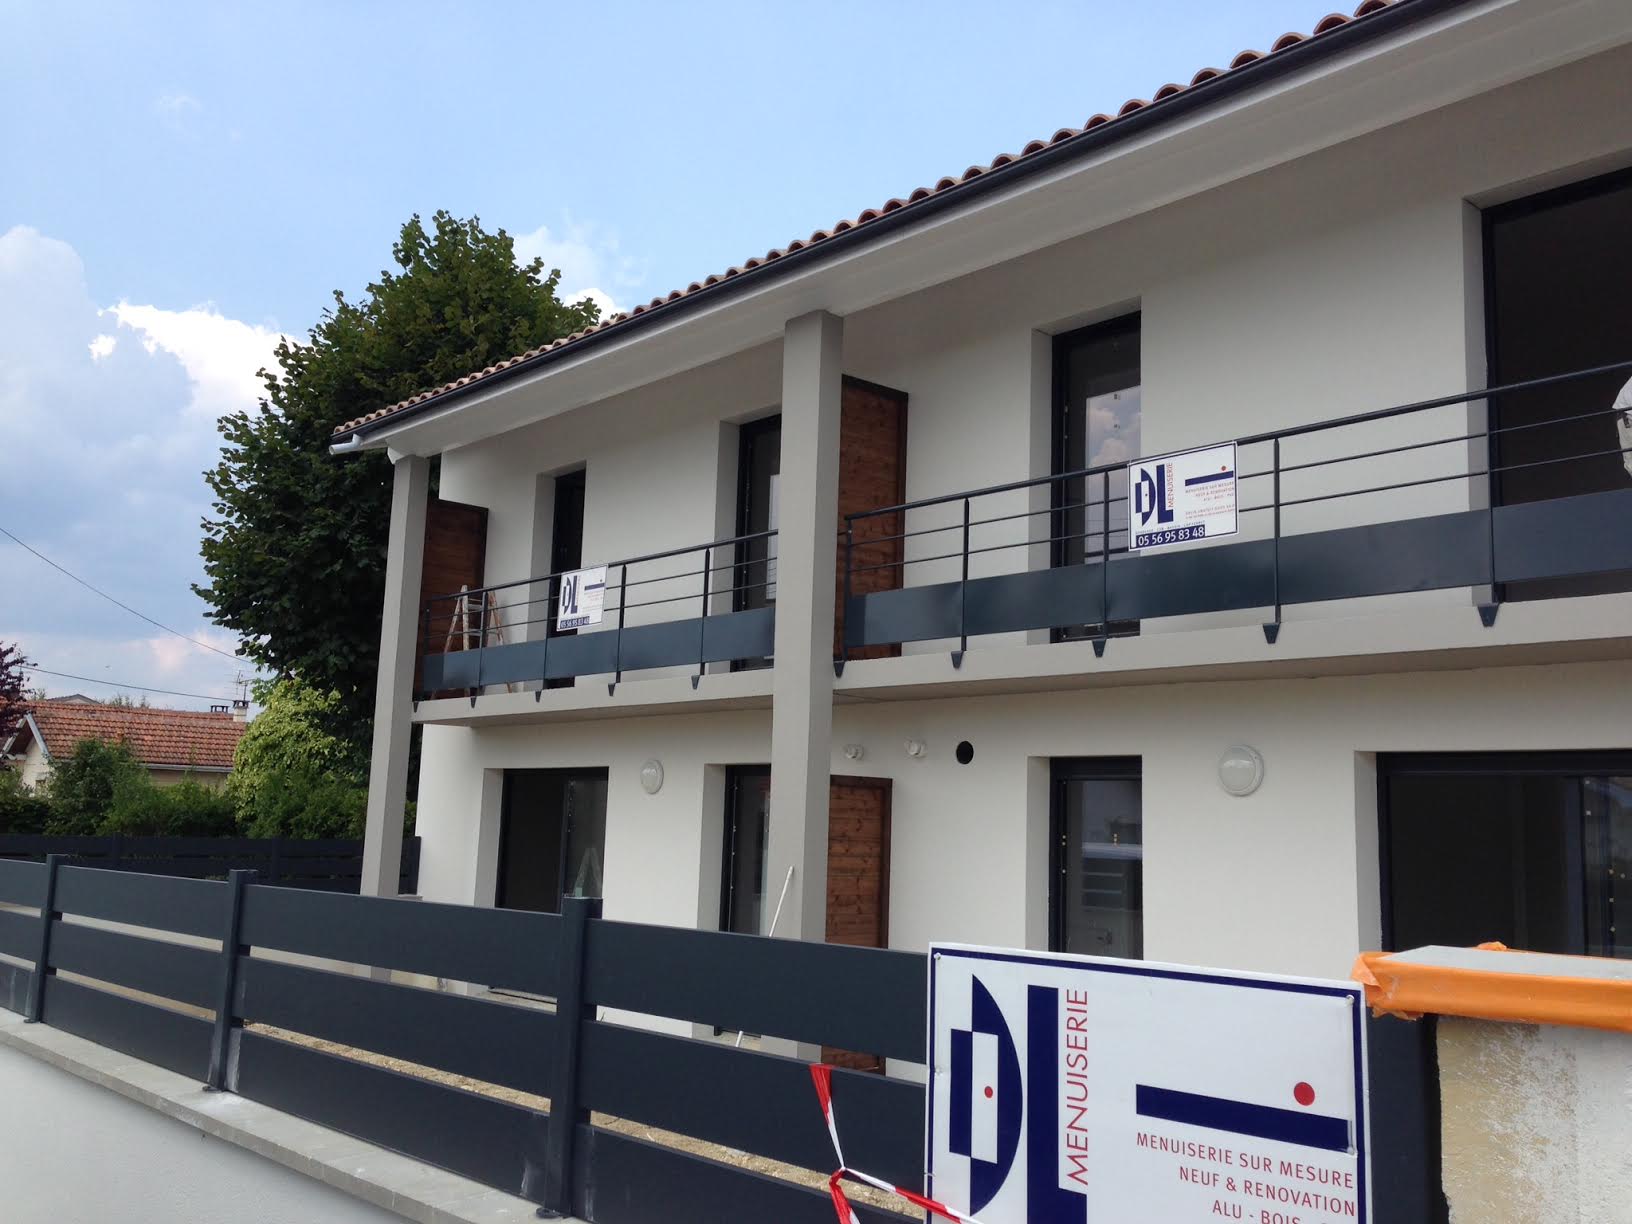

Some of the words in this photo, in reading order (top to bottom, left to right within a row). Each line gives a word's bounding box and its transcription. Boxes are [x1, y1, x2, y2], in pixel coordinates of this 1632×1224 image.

[1138, 535, 1150, 546] 05
[1151, 533, 1163, 545] 56
[1165, 531, 1176, 542] 95
[1178, 529, 1190, 540] 83
[1192, 526, 1204, 538] 48
[1066, 989, 1088, 1186] MENUISERIE
[1136, 1132, 1233, 1165] MENUISERIE
[1239, 1153, 1272, 1173] SUR
[1279, 1161, 1354, 1189] MESURE
[1179, 1166, 1220, 1188] NEUF
[1226, 1176, 1237, 1192] &
[1244, 1179, 1355, 1217] RENOVATION
[1212, 1200, 1242, 1219] ALU
